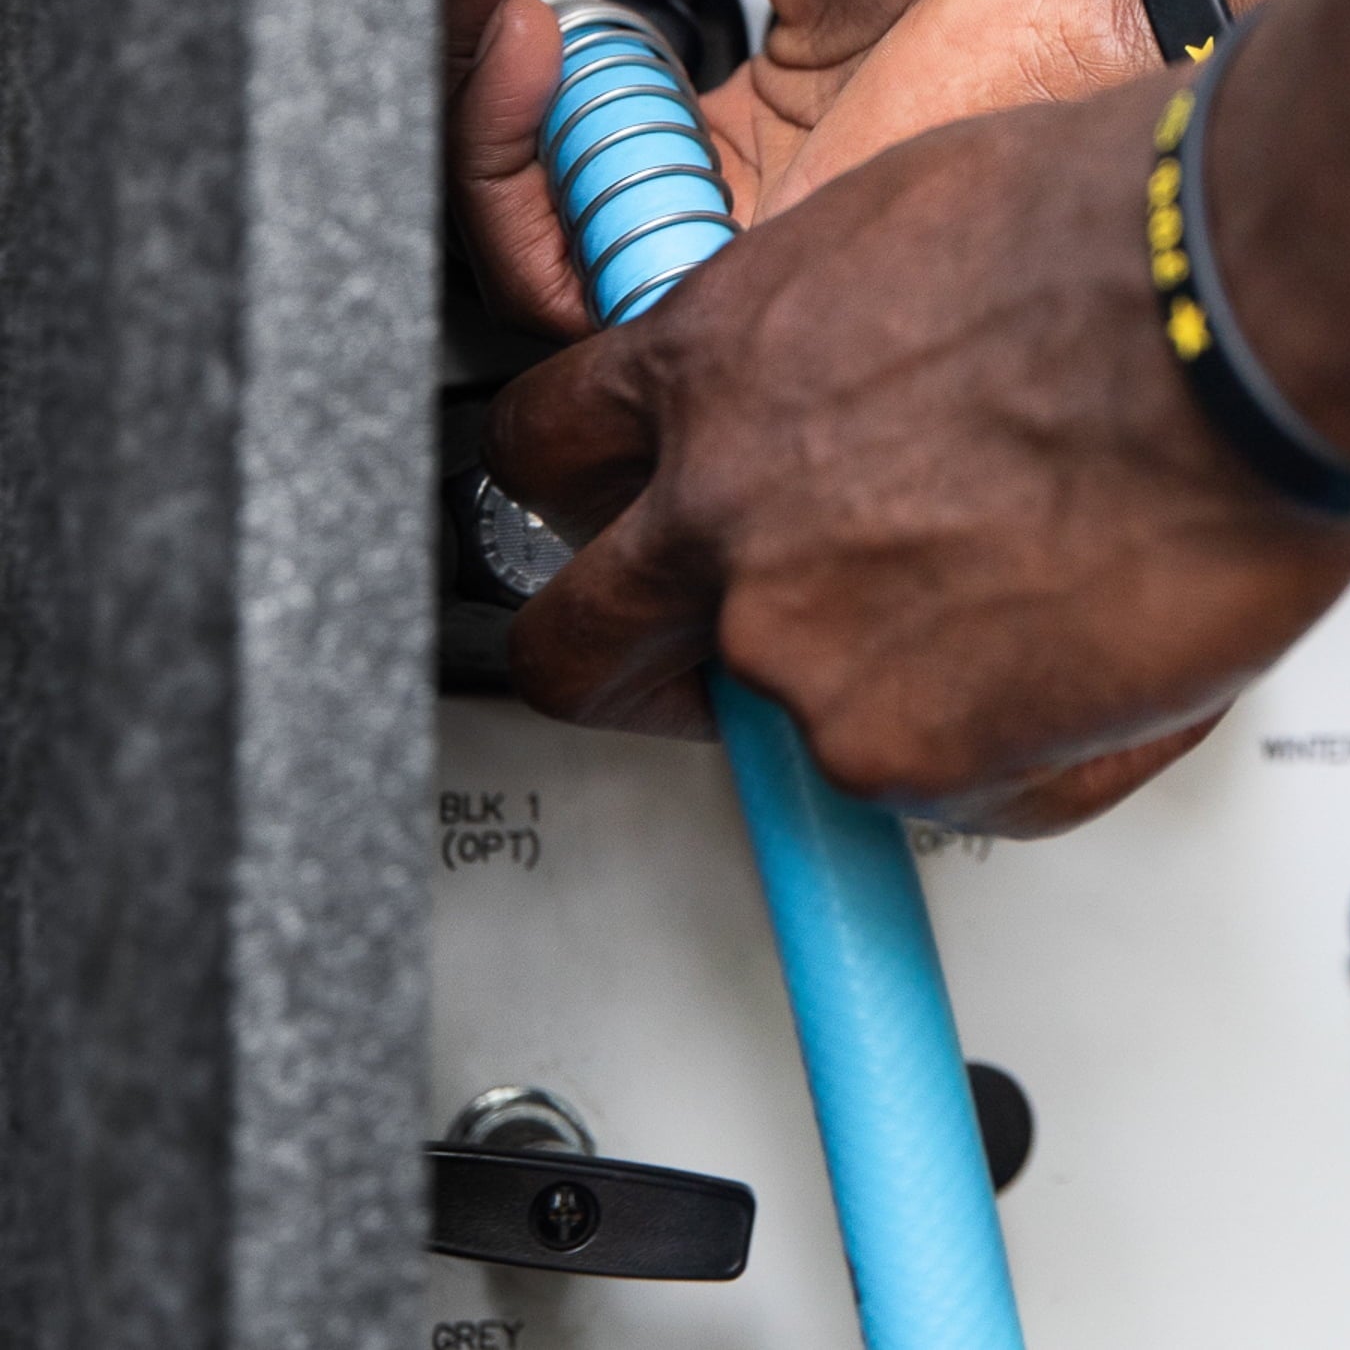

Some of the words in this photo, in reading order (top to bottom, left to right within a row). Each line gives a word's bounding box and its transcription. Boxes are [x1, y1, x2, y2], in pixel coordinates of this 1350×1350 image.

[440, 792, 504, 824] BLK
[528, 792, 540, 821] 1
[442, 828, 540, 871] (OPT)
[432, 1319, 524, 1350] GREY
